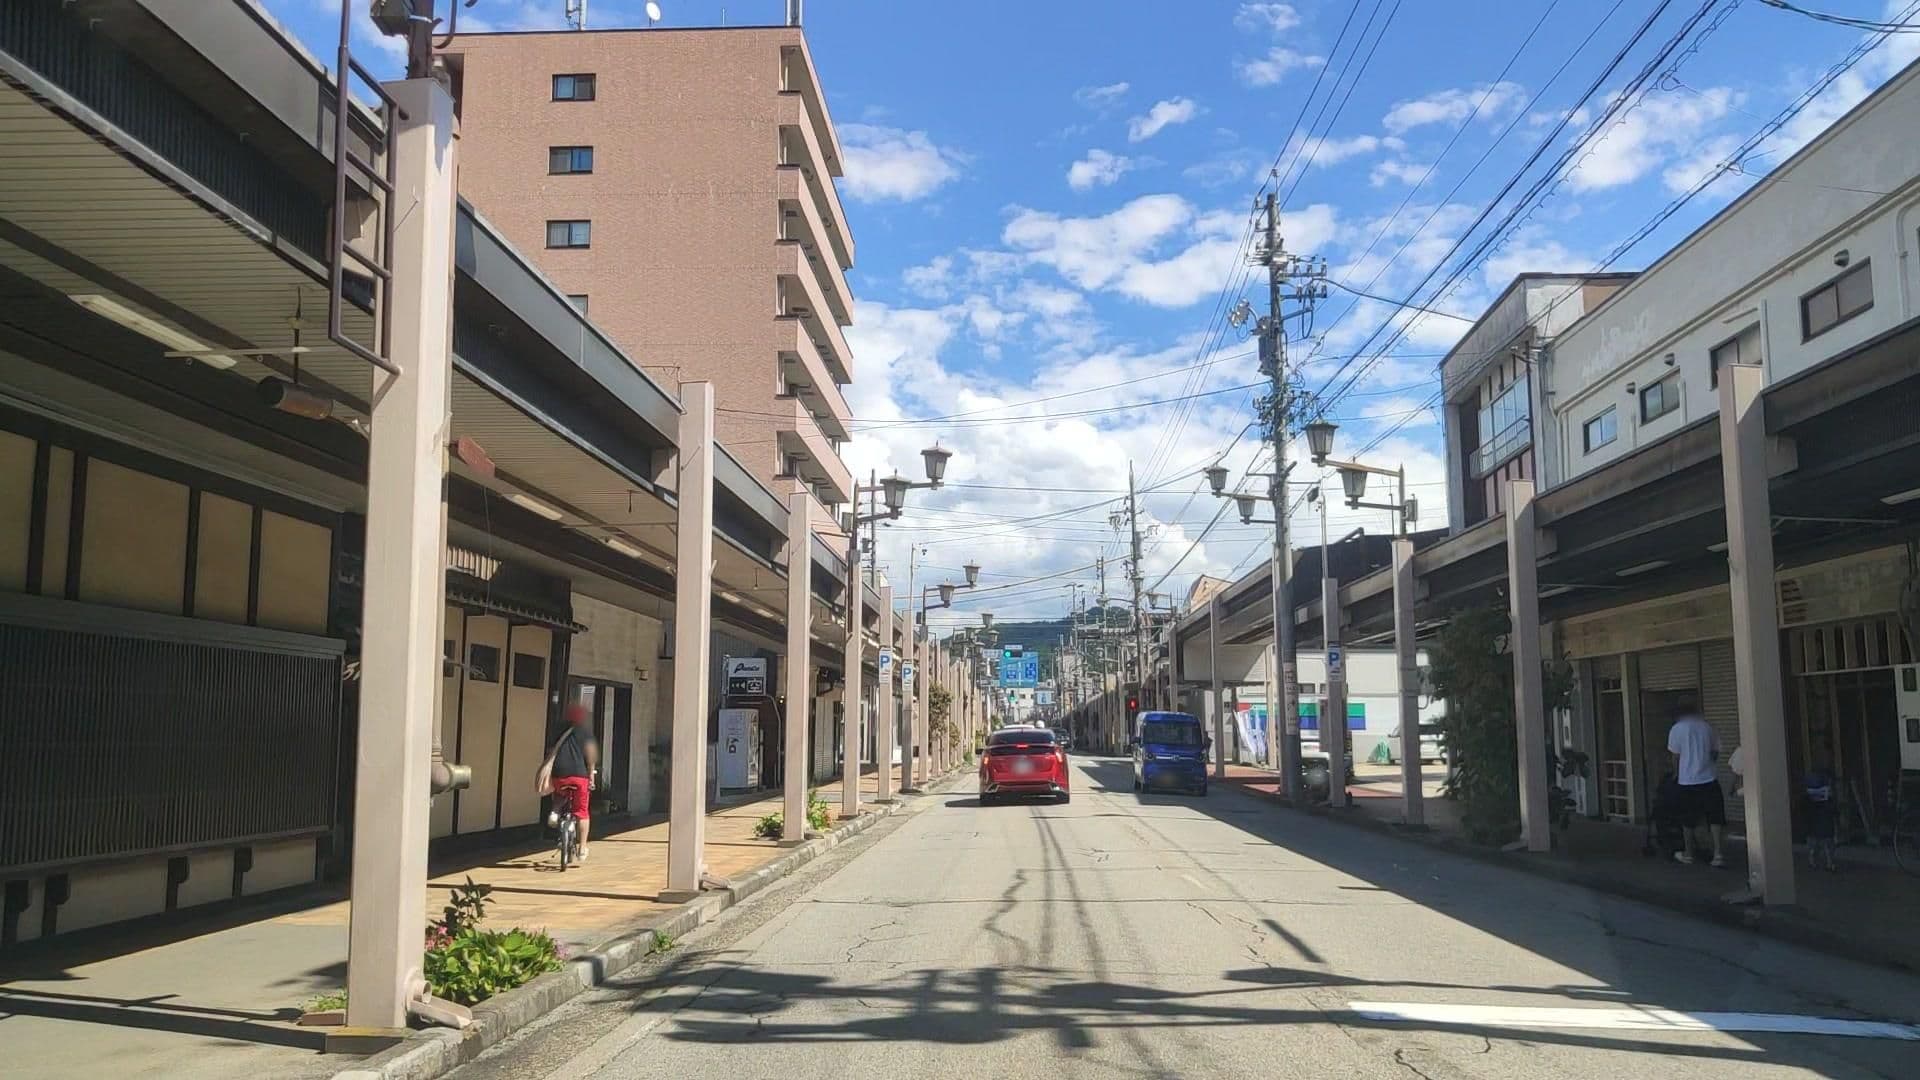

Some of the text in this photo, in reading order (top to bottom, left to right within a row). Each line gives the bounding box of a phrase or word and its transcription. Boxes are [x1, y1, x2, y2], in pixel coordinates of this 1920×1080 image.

[880, 655, 890, 668] P
[1328, 652, 1340, 666] P
[903, 667, 912, 679] P
